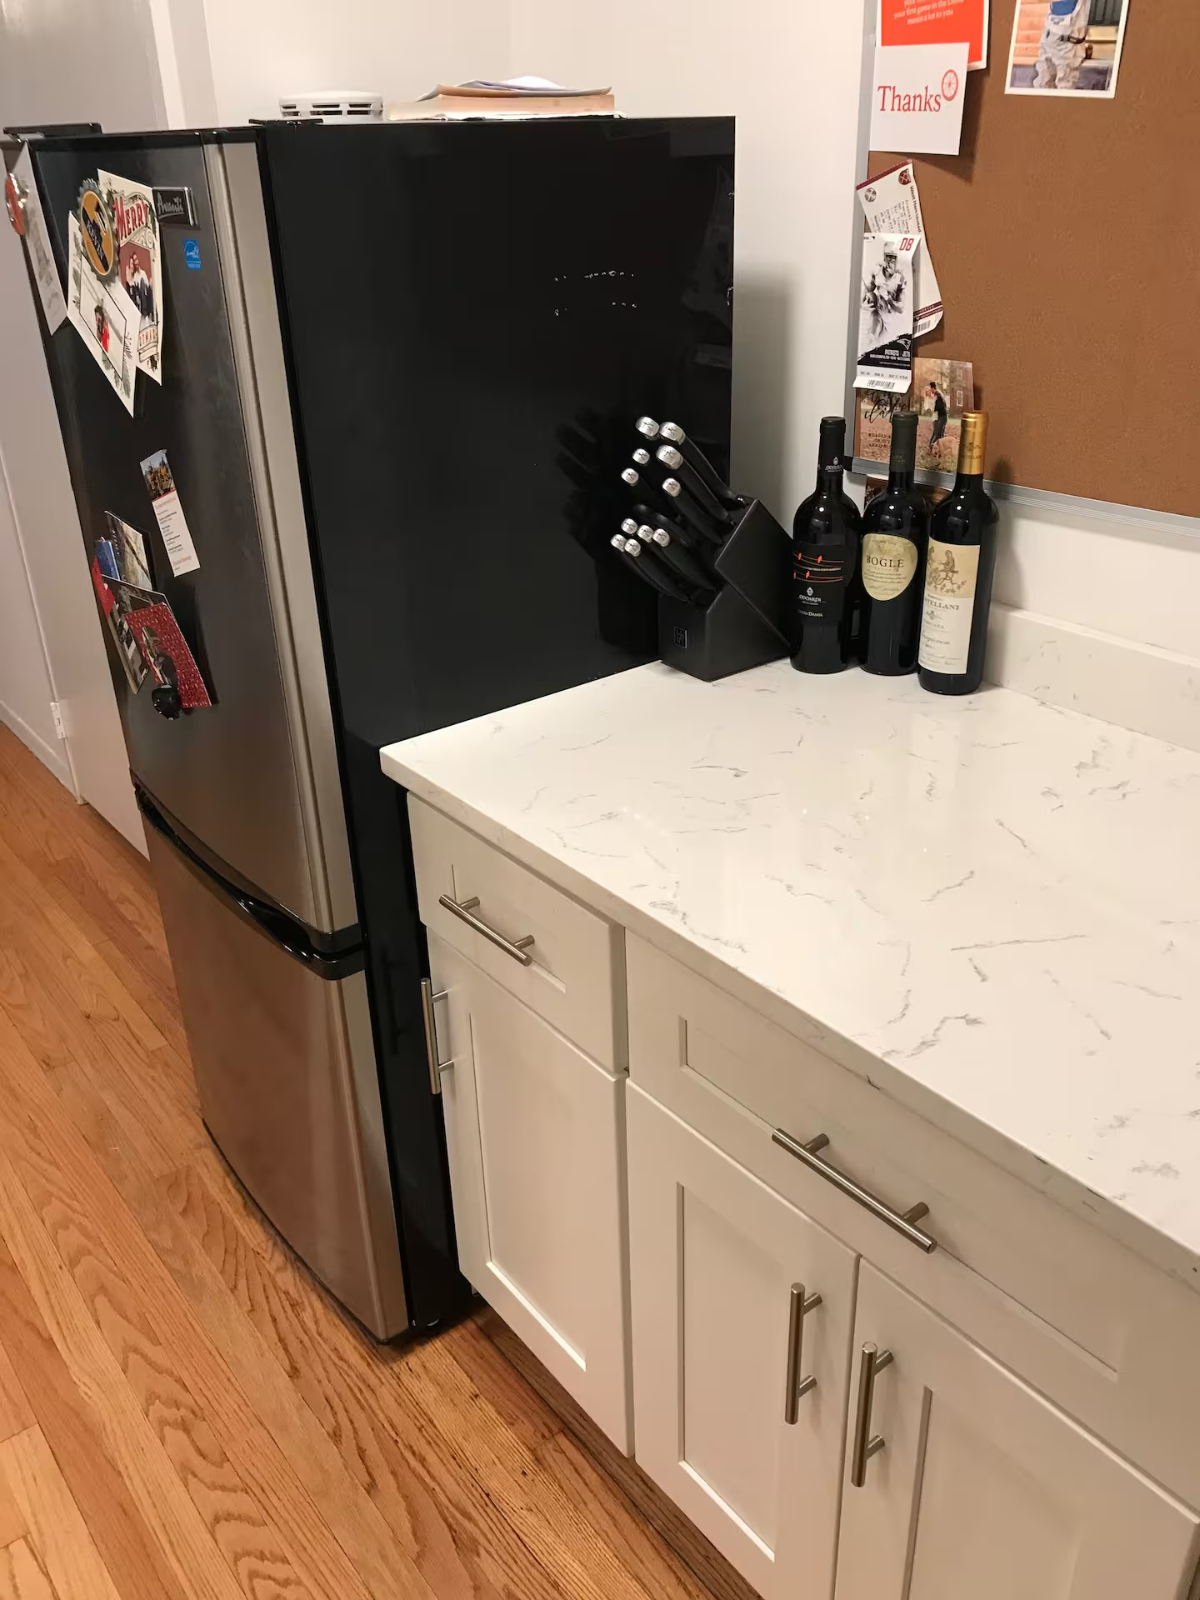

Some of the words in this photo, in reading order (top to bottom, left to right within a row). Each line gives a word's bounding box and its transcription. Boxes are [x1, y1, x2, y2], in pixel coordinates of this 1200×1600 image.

[877, 85, 942, 113] Thanks
[112, 196, 149, 240] MERRY
[866, 554, 905, 568] BOGLE
